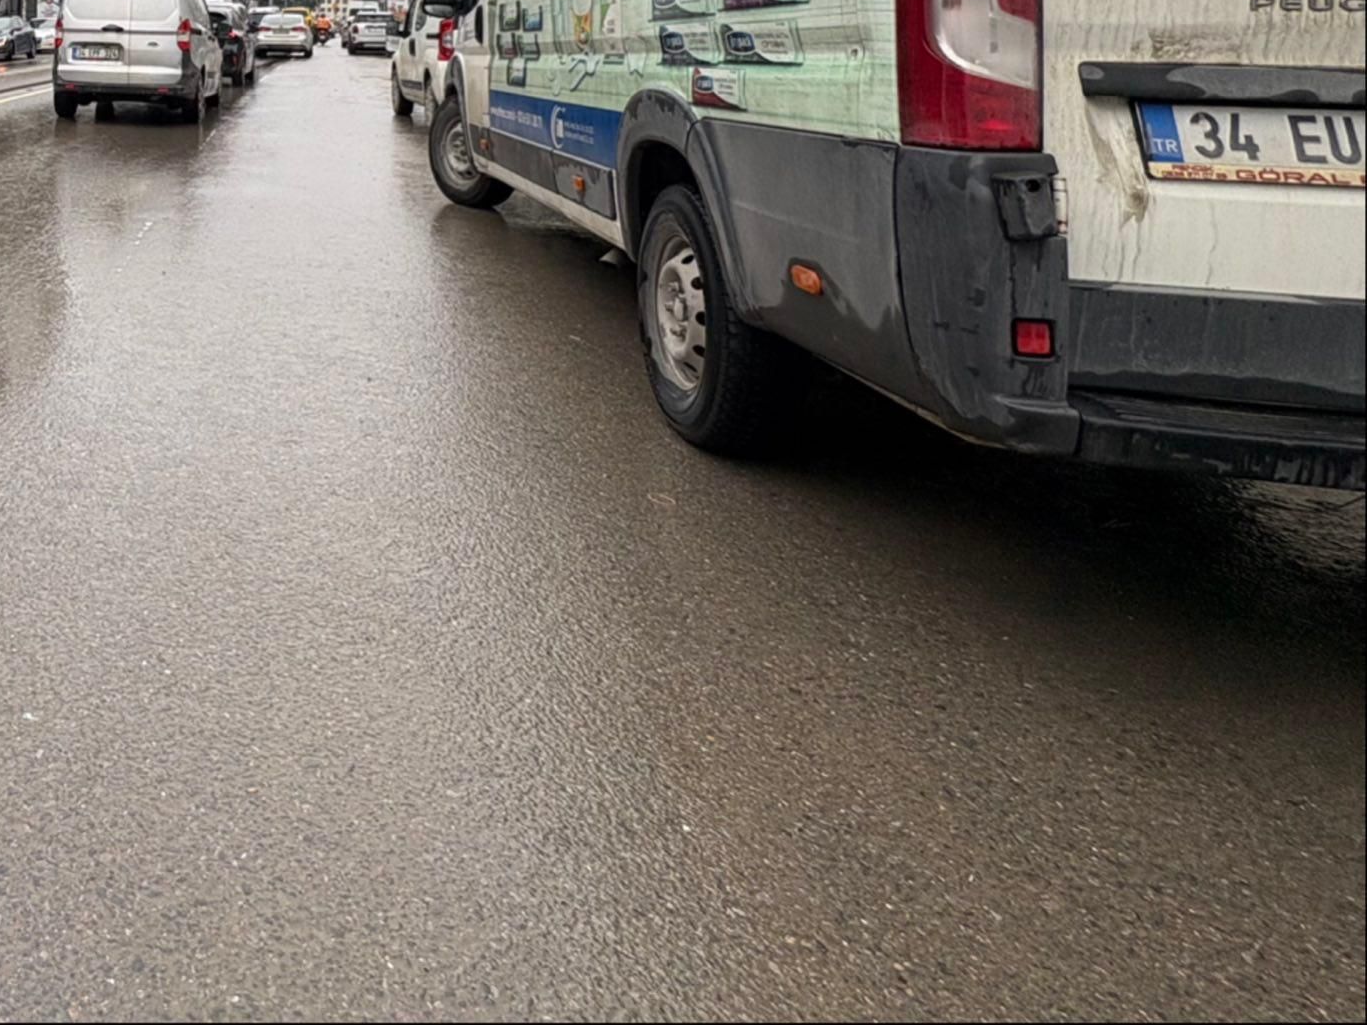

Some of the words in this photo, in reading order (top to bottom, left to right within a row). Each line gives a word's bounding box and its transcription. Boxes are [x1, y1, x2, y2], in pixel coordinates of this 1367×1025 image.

[1154, 138, 1179, 153] TR
[1189, 111, 1260, 162] 34
[1287, 114, 1362, 165] EU
[1235, 168, 1351, 186] GÖRAL
